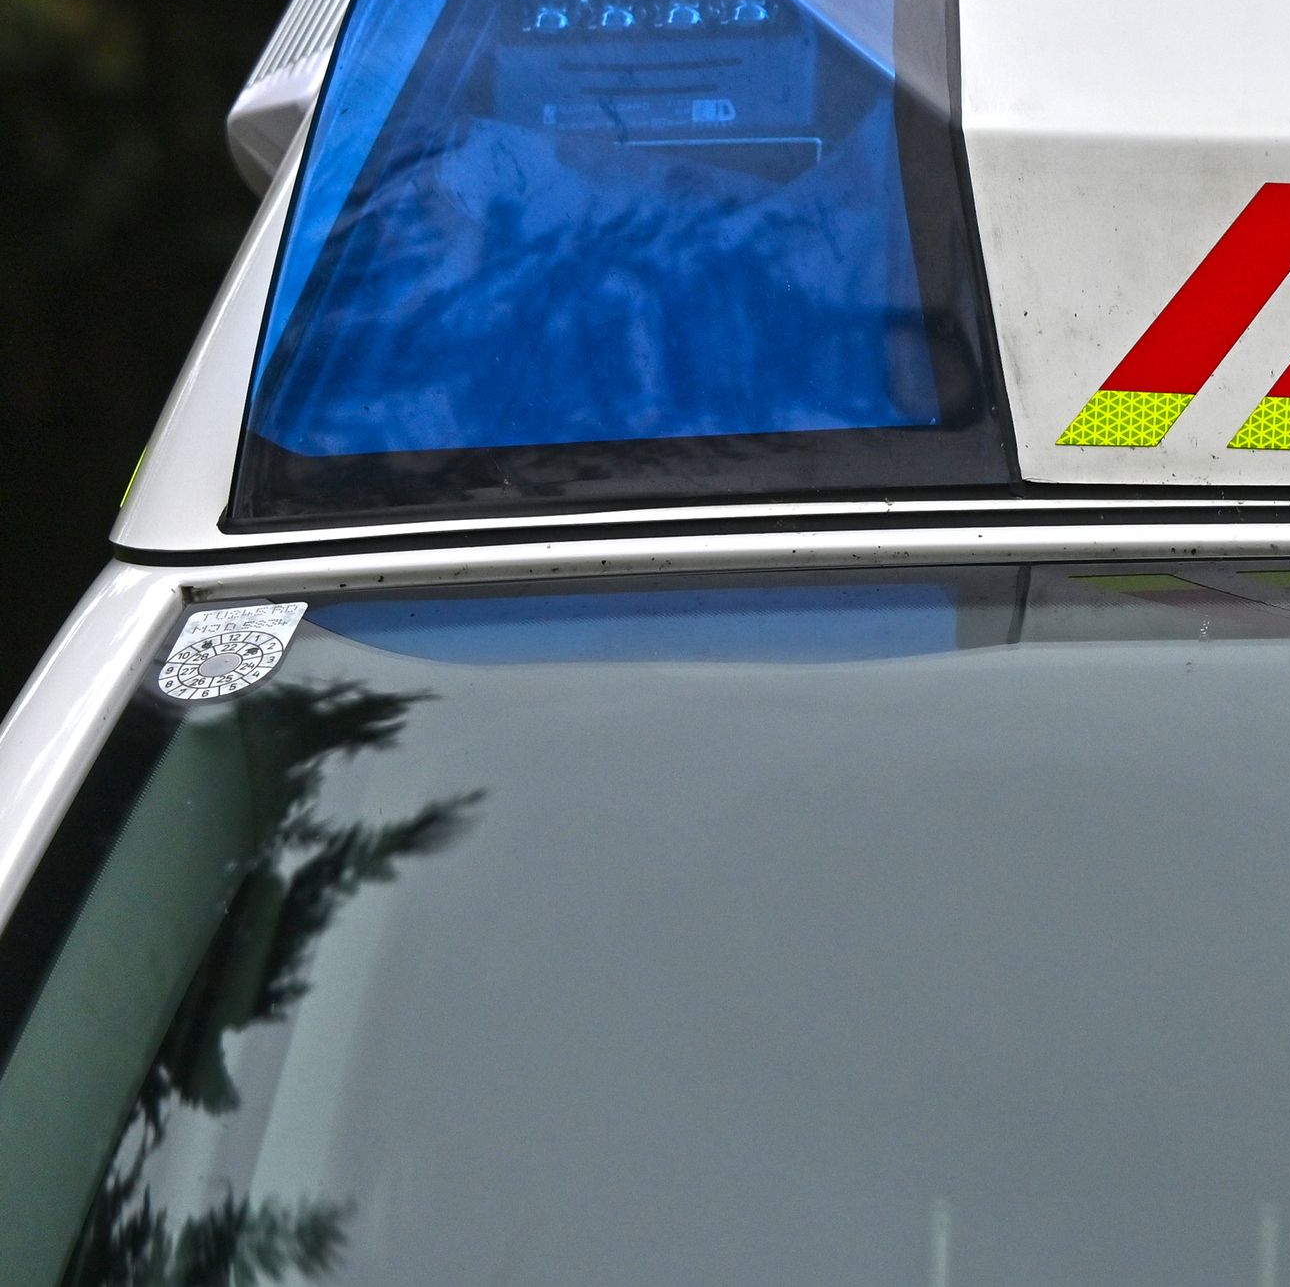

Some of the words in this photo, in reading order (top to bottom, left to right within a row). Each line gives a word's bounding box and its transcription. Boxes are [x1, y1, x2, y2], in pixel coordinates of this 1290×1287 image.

[228, 633, 242, 642] 12
[254, 634, 261, 643] 1
[220, 643, 238, 653] 22
[267, 642, 277, 651] 2
[177, 651, 191, 661] 10
[193, 653, 209, 662] 28
[267, 655, 276, 664] 3
[165, 666, 175, 675] 9
[239, 661, 255, 671] 24
[179, 667, 198, 676] 27
[252, 670, 261, 679] 4
[189, 678, 207, 687] 26
[216, 674, 234, 684] 25
[164, 680, 174, 689] 8
[228, 682, 238, 691] 5
[201, 689, 210, 698] 6
